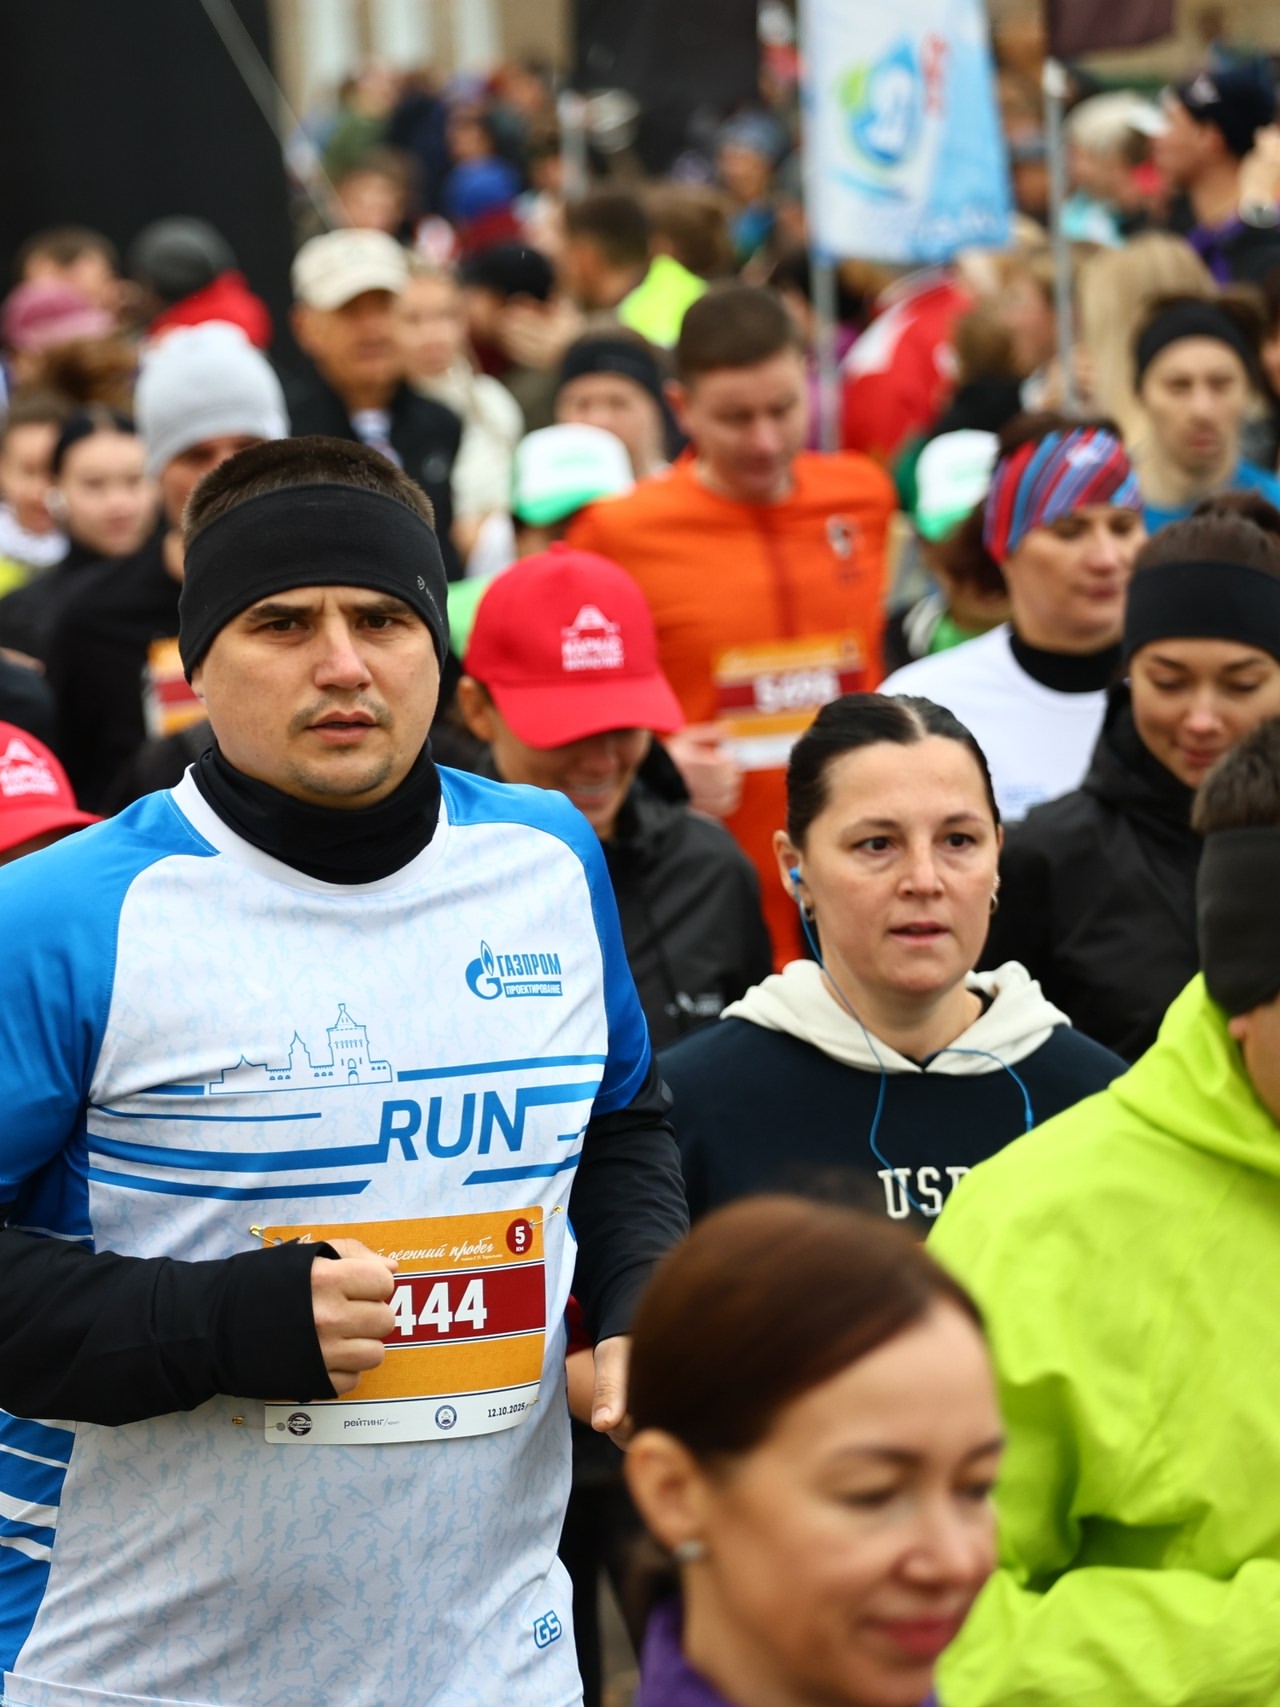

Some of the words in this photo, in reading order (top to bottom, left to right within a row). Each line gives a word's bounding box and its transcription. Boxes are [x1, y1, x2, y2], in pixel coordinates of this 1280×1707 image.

[496, 953, 561, 977] ГАЗПРОМ
[505, 983, 561, 995] ПРОЕКТИРОВАНИЕ
[378, 1090, 526, 1163] RUN
[515, 1226, 525, 1245] 5
[388, 1243, 448, 1261] осенний
[449, 1235, 494, 1263] пробег
[388, 1278, 488, 1336] 444
[487, 1402, 526, 1418] 12.10.2025
[533, 1609, 562, 1649] GS
